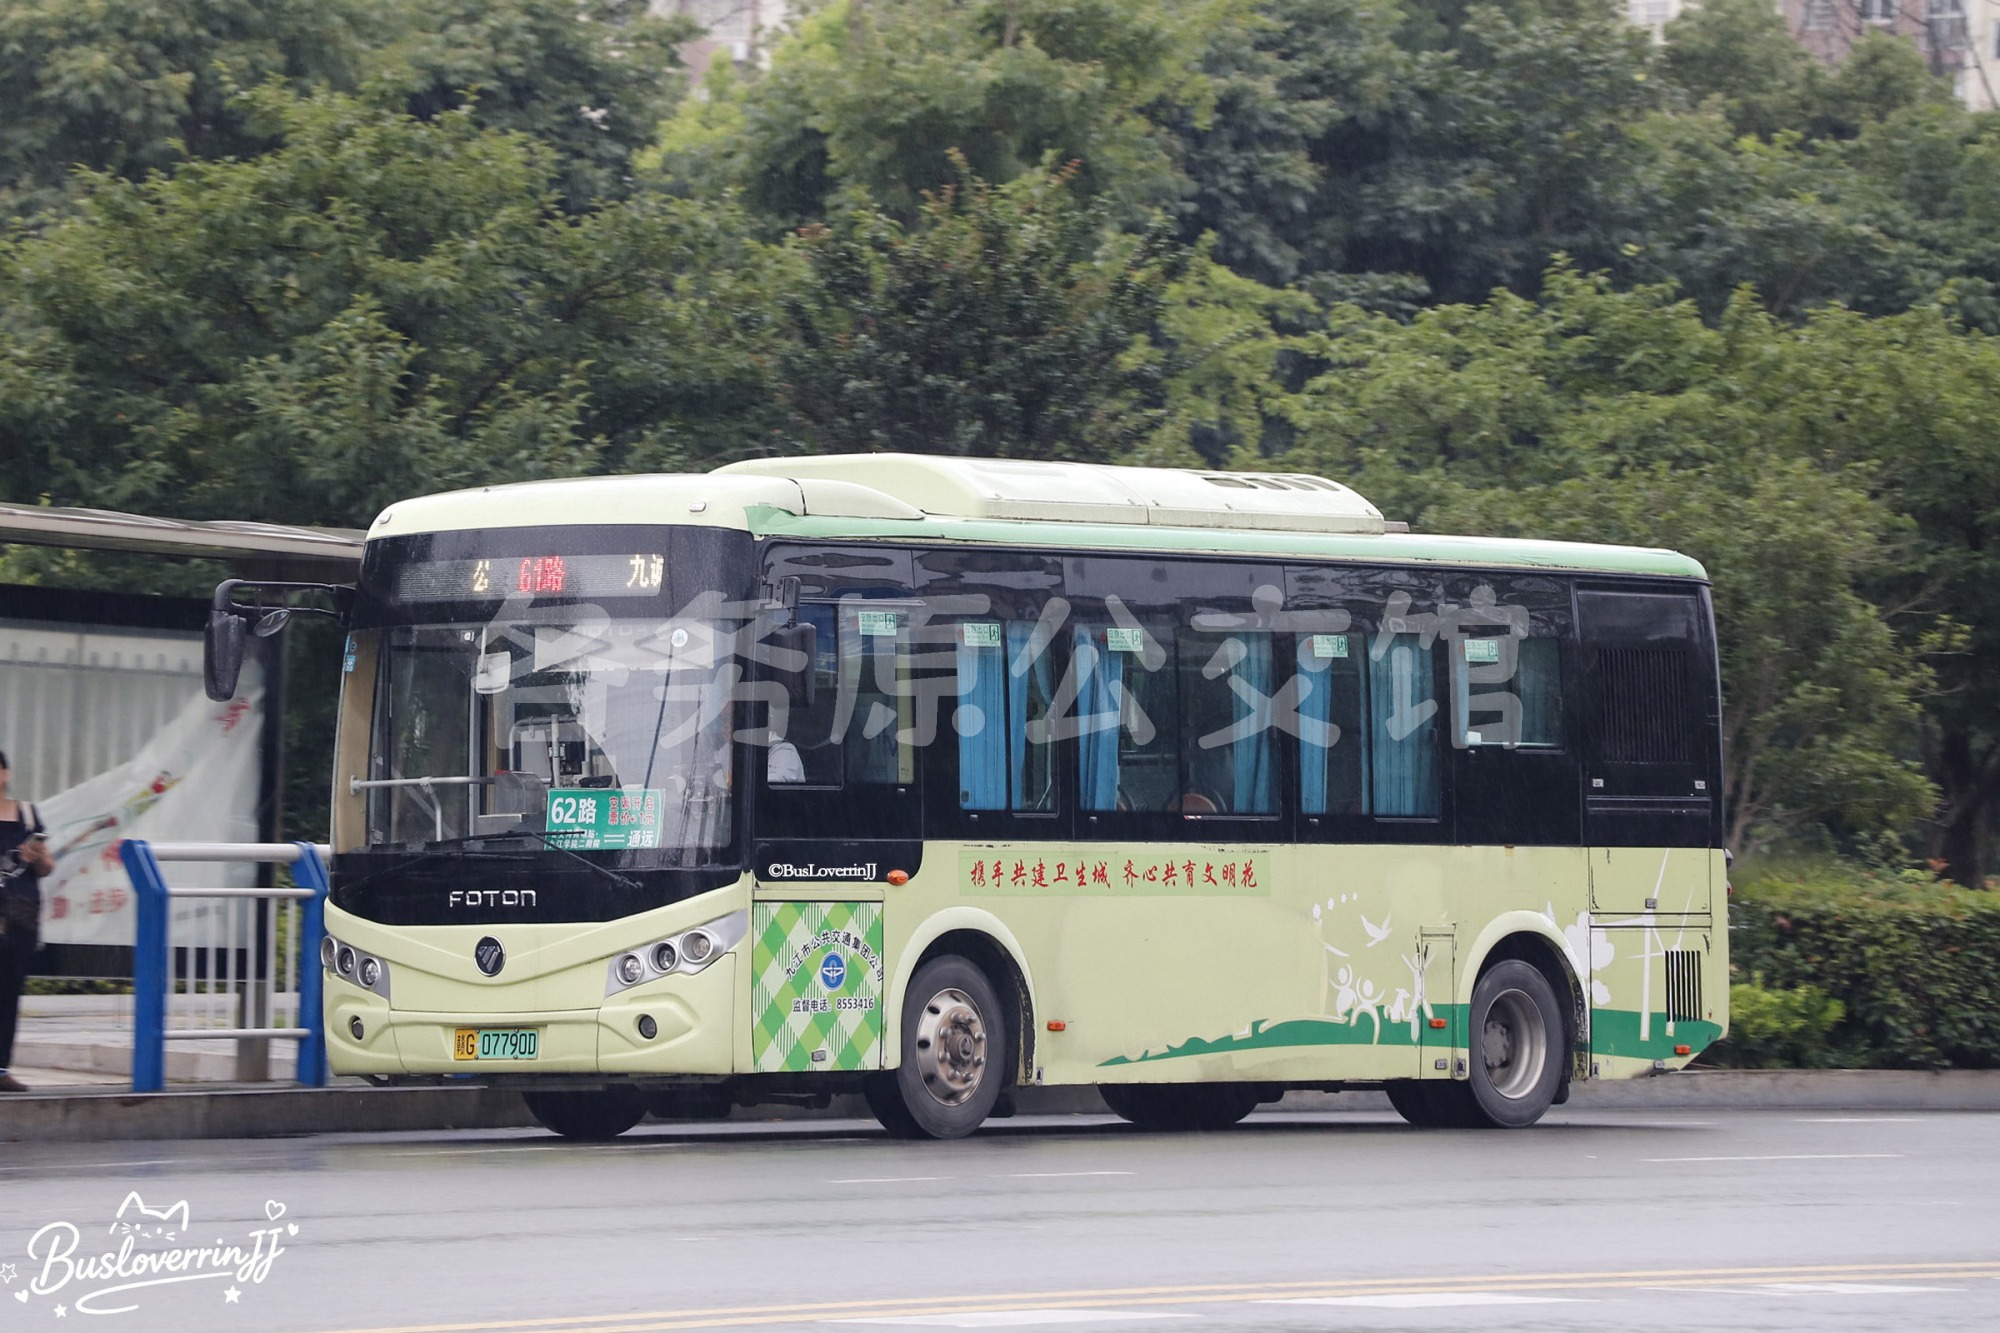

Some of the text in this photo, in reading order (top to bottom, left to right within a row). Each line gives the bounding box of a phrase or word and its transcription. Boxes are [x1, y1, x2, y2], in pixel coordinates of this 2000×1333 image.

[517, 556, 565, 592] 61路
[551, 797, 597, 825] 62路
[627, 830, 654, 848] 通远
[970, 857, 1258, 889] 携手共建卫生城 齐心共育文明花
[449, 889, 537, 907] FOTON
[785, 930, 884, 982] 九江市公共交通集团公司
